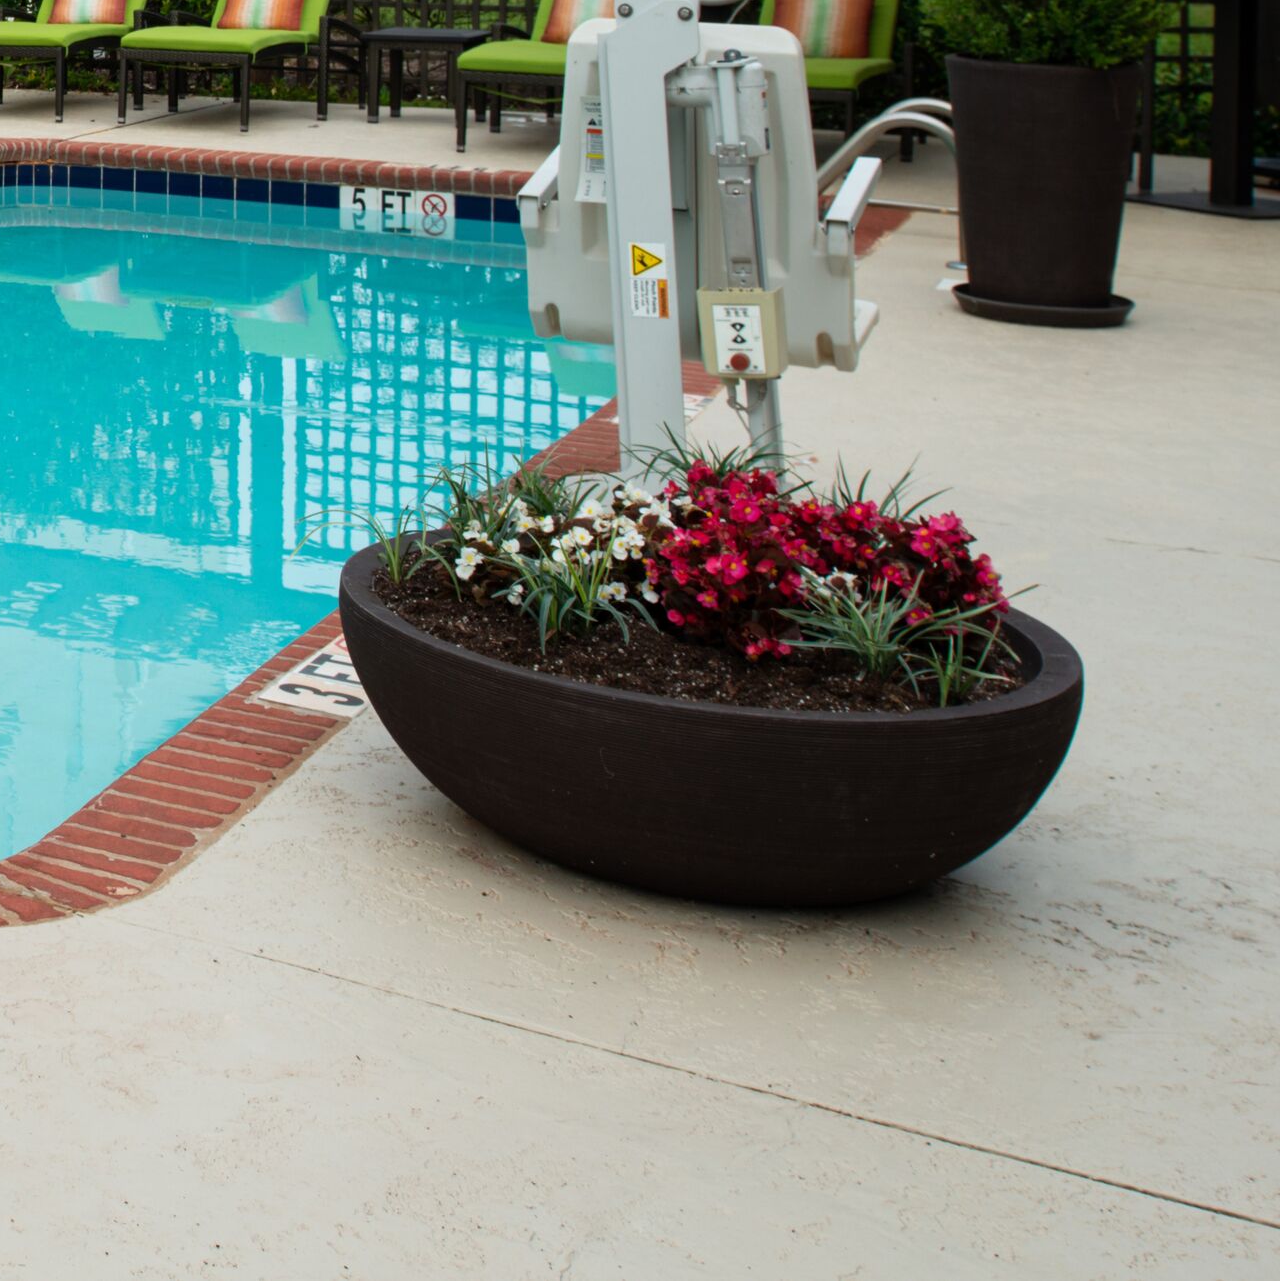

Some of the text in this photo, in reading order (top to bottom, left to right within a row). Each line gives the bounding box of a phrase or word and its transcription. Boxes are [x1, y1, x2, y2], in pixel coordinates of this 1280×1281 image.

[352, 188, 412, 214] 5 FT
[279, 683, 365, 707] 3
